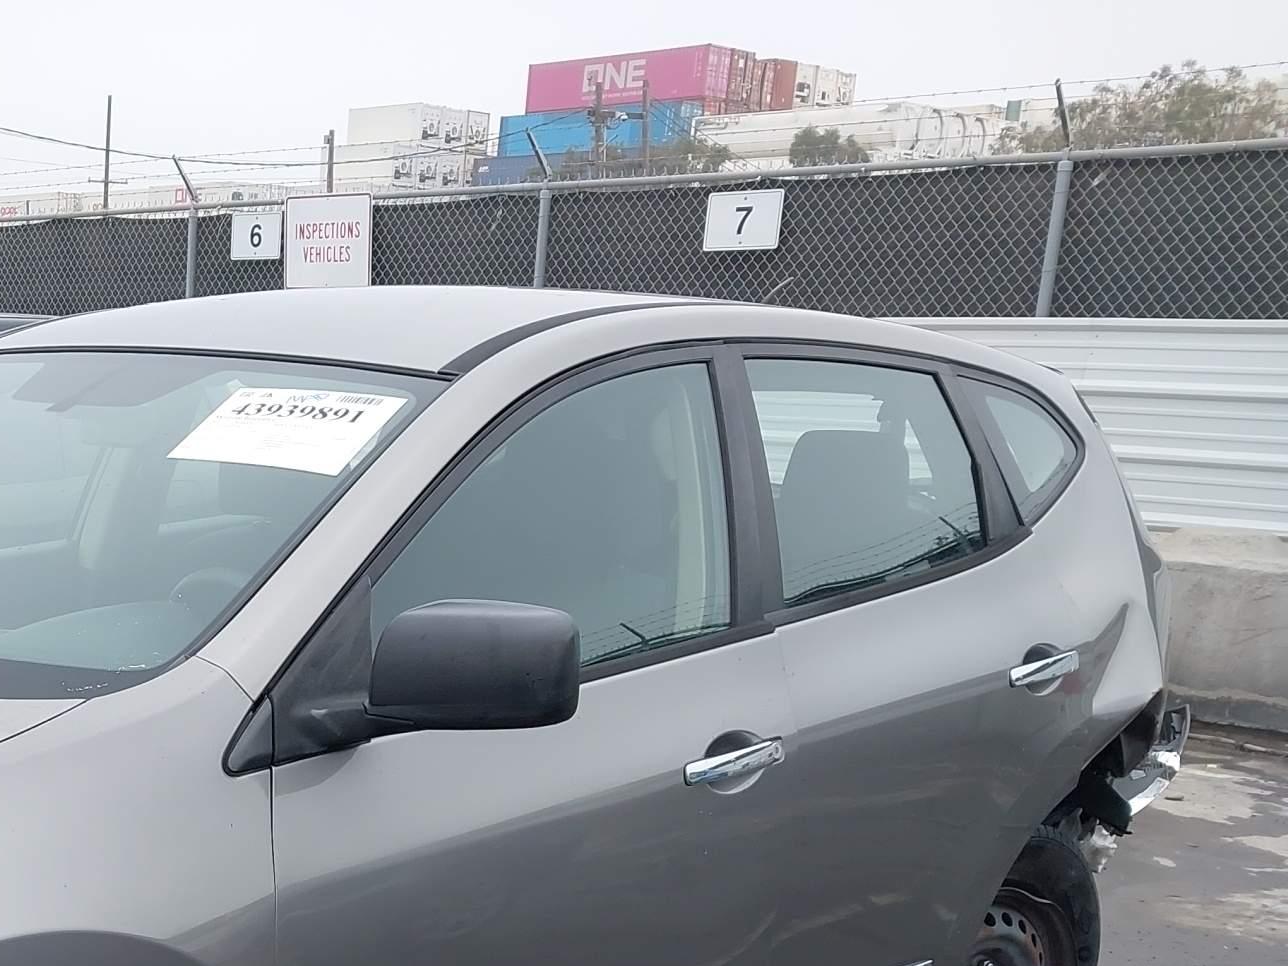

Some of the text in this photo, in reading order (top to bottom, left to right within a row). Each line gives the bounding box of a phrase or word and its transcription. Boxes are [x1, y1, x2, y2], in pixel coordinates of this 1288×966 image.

[581, 58, 647, 93] ONE
[295, 221, 361, 240] INSPECTIONS
[735, 206, 754, 235] 7
[250, 224, 262, 248] 6
[303, 246, 351, 263] VEHICLES
[232, 402, 364, 424] 43939891
